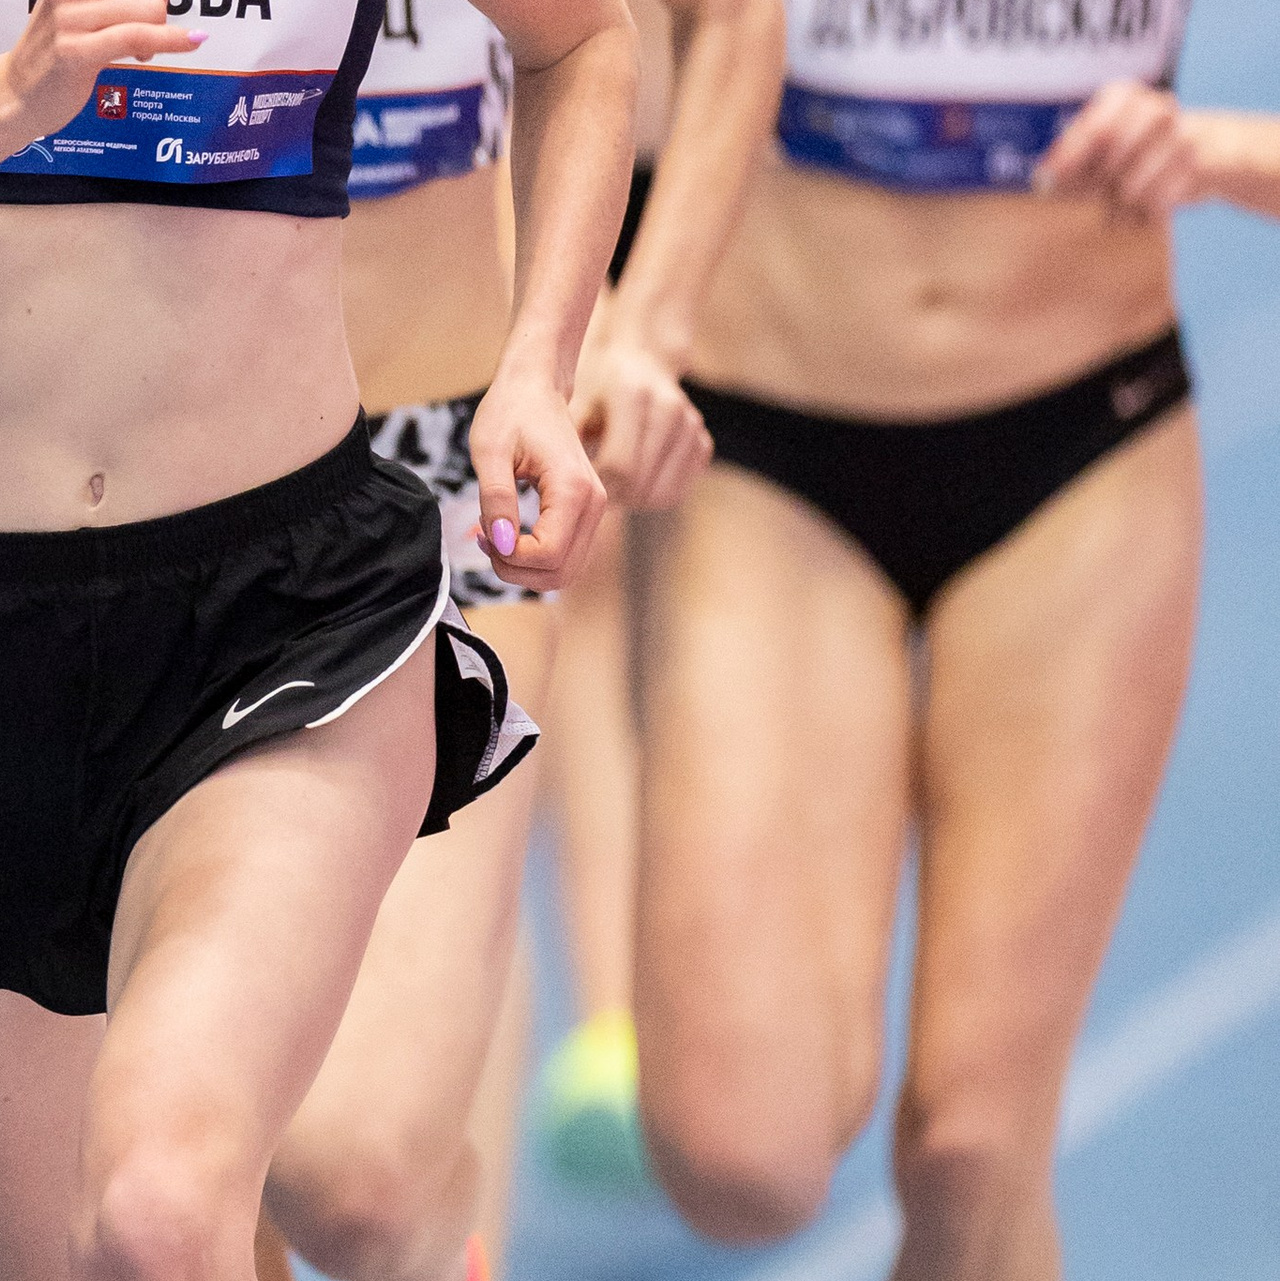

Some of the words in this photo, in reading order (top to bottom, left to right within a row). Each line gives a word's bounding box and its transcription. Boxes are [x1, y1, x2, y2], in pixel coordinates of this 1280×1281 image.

[133, 87, 193, 101] Департамент
[132, 100, 163, 110] спорта
[132, 111, 163, 122] города
[164, 112, 201, 124] Москвы
[185, 148, 260, 165] ЗАРУБЕЖНЕФТЬ
